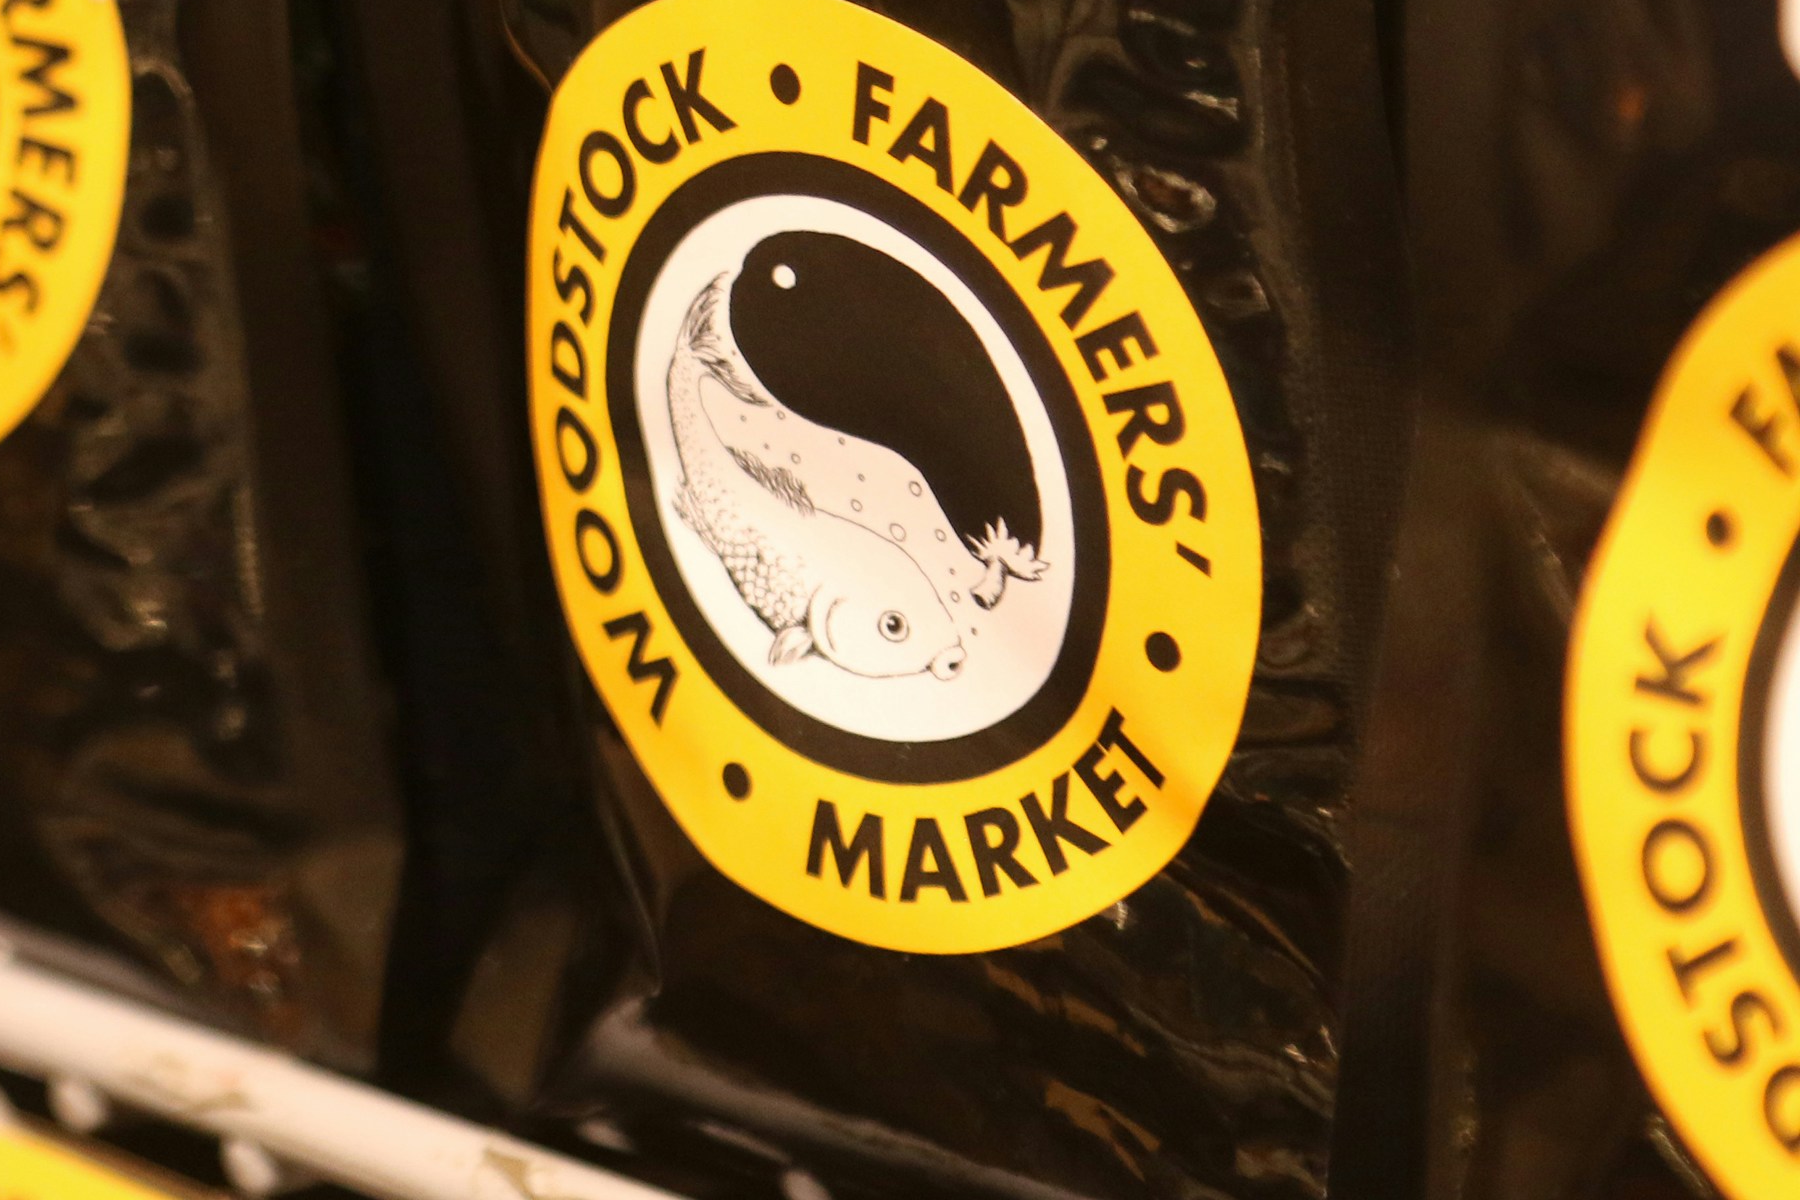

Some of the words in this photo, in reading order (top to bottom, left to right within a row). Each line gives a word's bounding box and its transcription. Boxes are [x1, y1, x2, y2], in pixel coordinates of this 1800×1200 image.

[550, 48, 738, 730] WOODSTOCK
[851, 60, 1211, 578] FARMERS'
[805, 707, 1165, 903] MARKET
